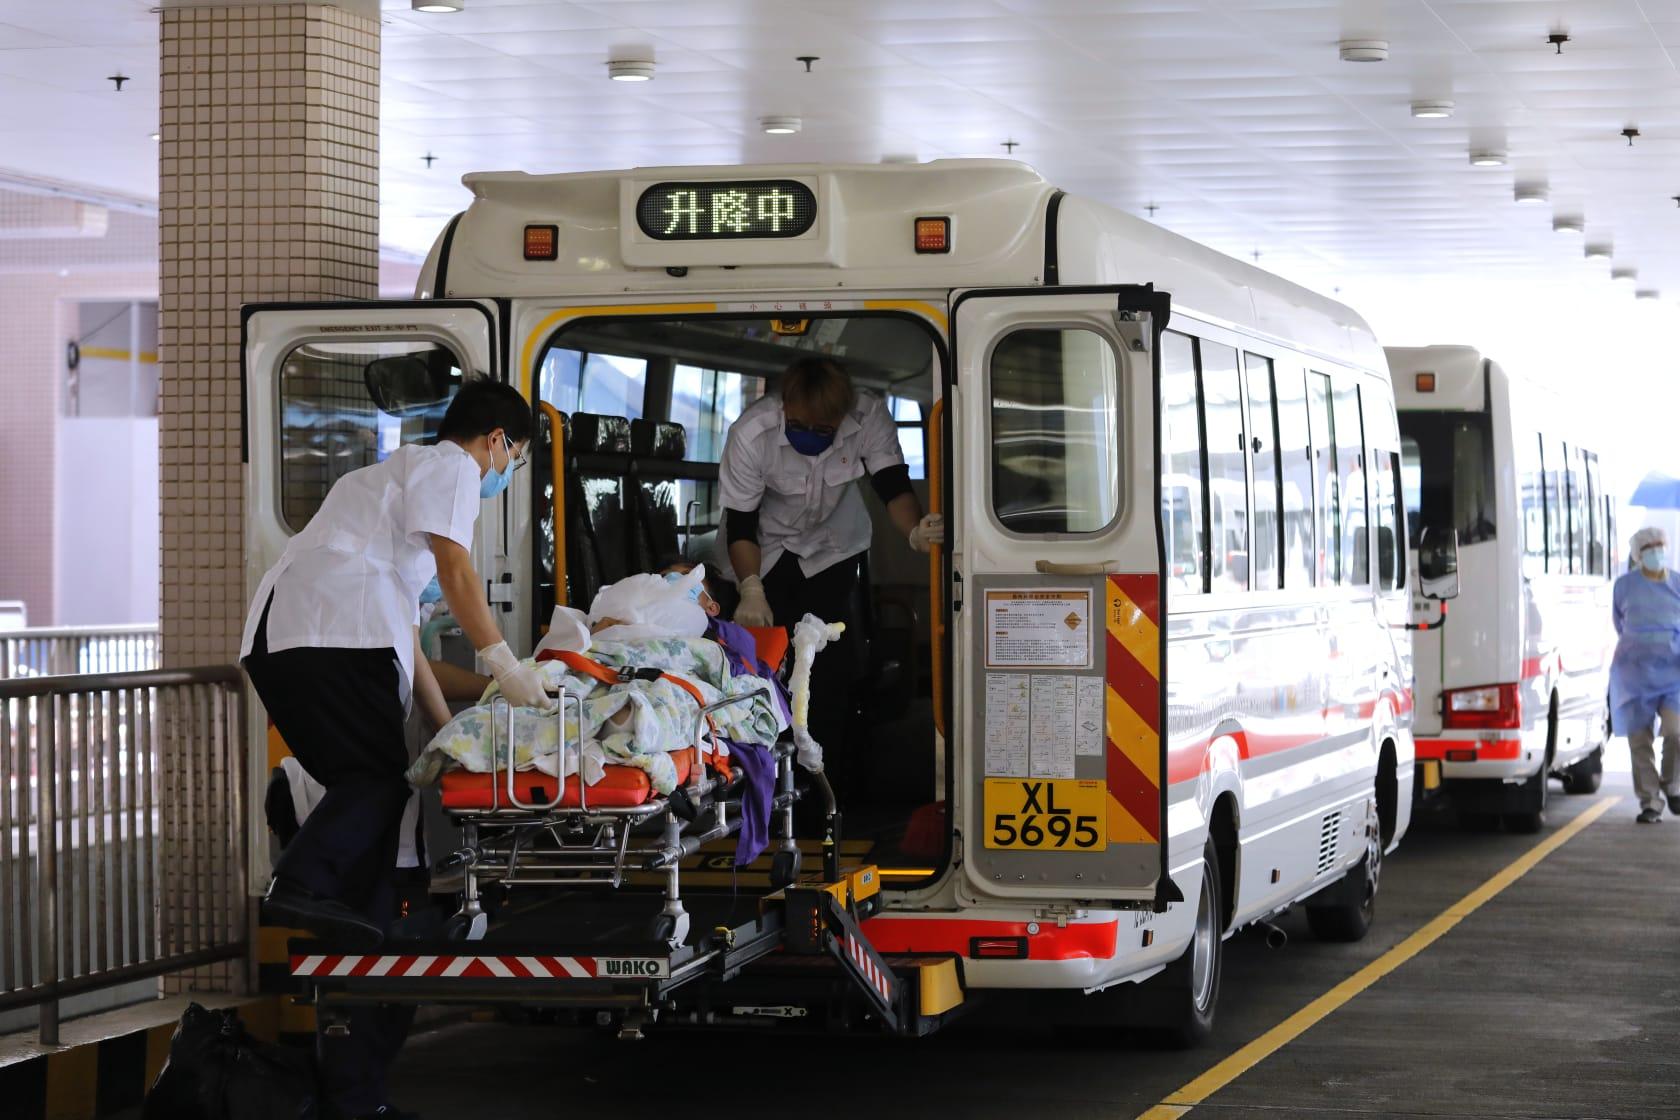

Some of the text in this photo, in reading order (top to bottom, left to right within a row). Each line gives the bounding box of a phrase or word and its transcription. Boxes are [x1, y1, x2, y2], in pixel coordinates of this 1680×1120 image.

[664, 190, 794, 234] 升降中
[1021, 782, 1072, 815] XL
[993, 814, 1099, 848] 5695
[606, 960, 660, 975] WAKO
